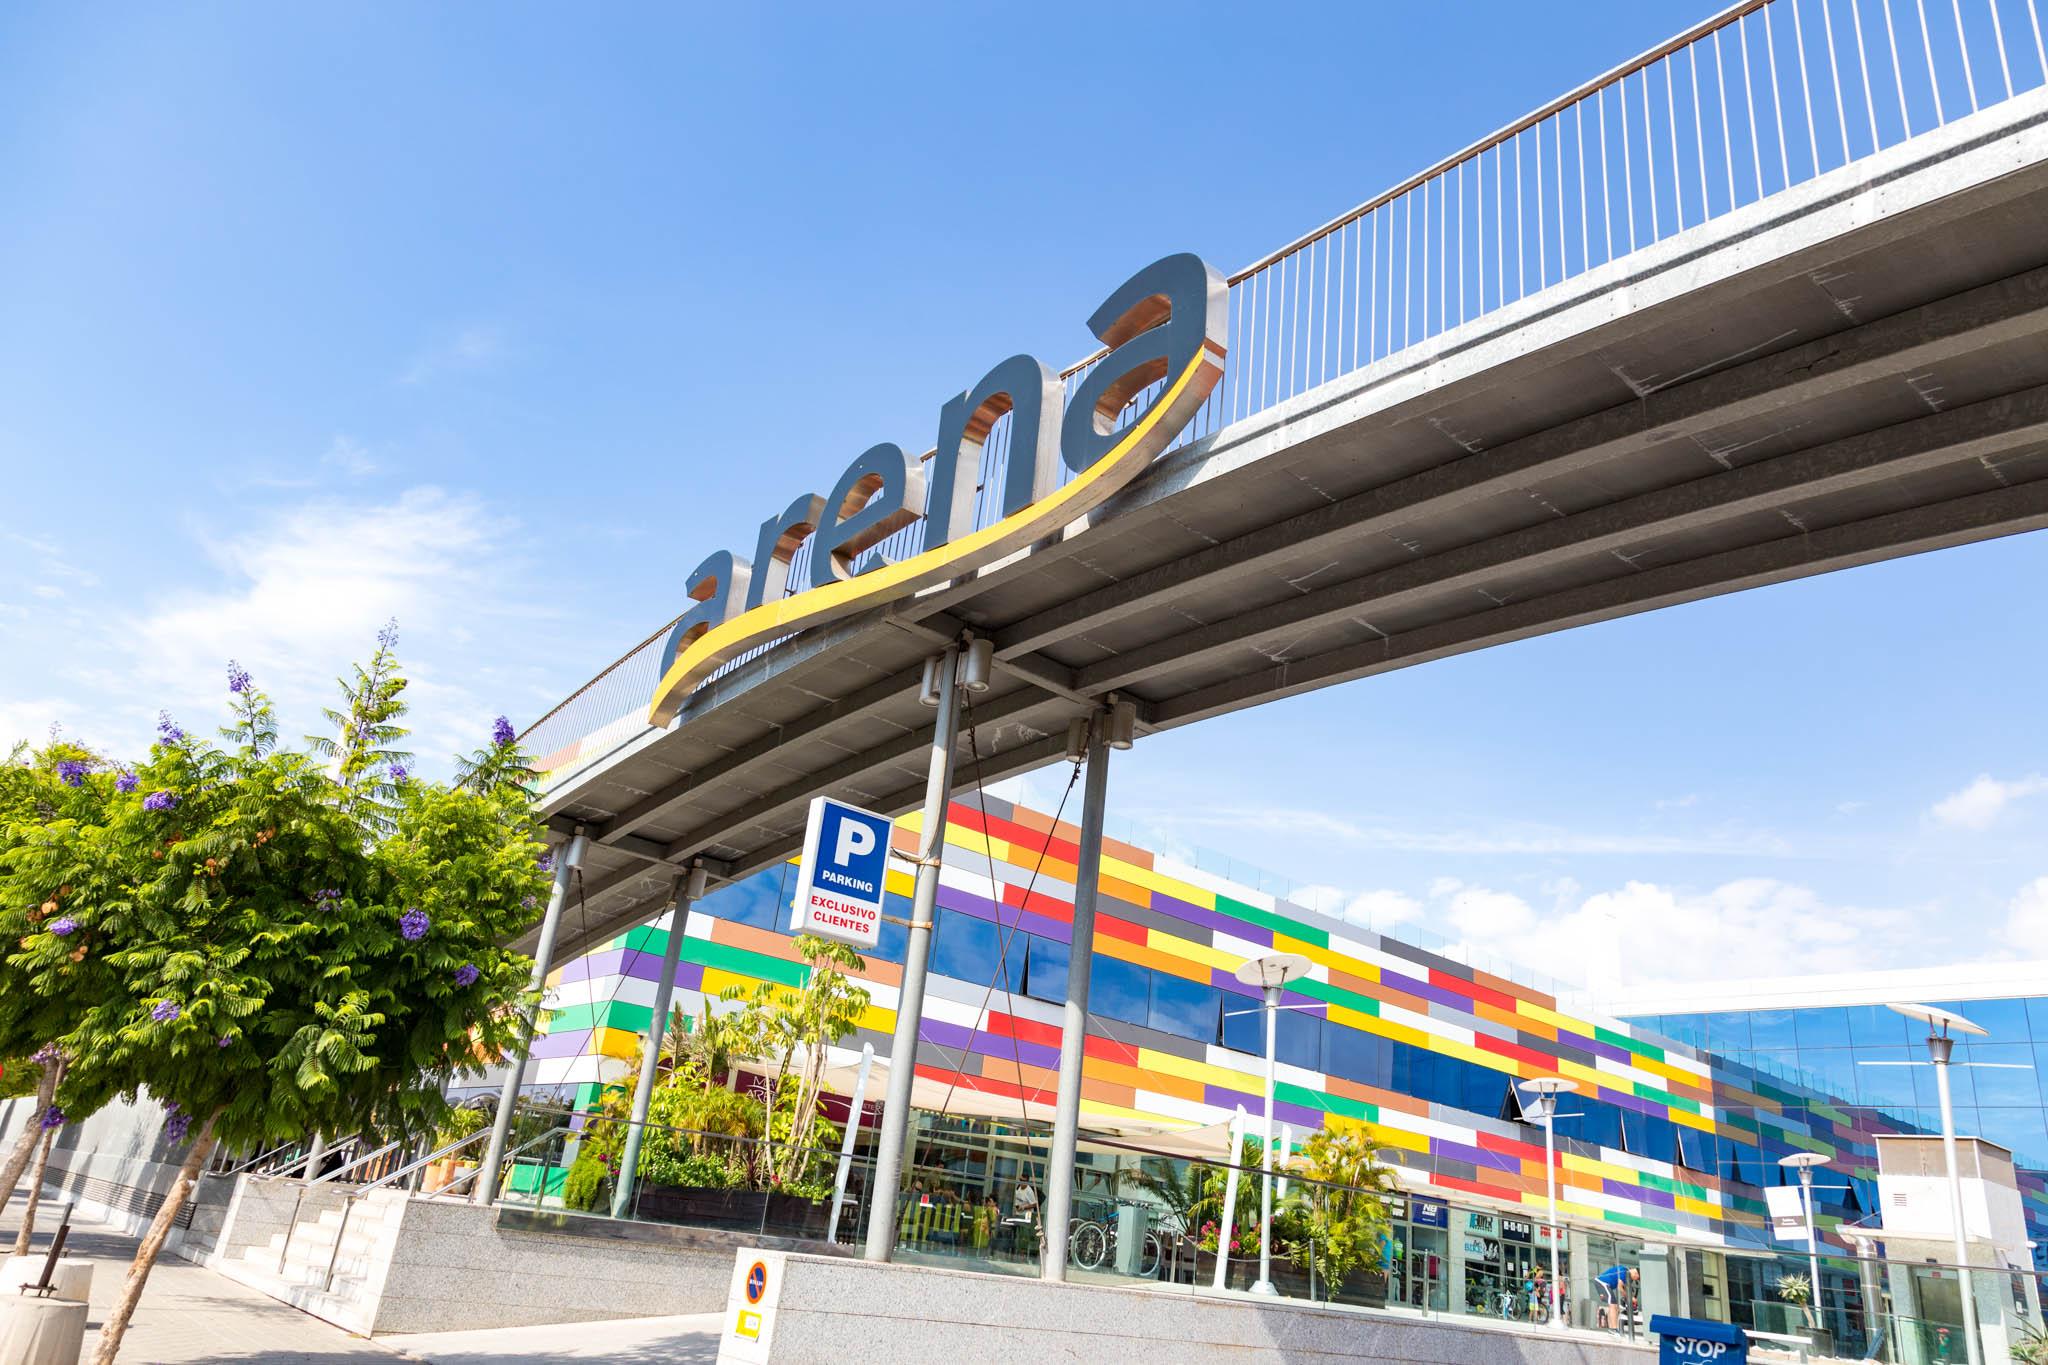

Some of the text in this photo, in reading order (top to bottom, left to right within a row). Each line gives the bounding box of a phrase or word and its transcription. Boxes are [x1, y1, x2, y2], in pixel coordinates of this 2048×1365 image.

[658, 252, 1224, 688] arena
[833, 816, 877, 868] P
[822, 869, 874, 893] PARKING
[810, 895, 877, 921] EXCLUSIVO
[813, 911, 870, 934] CLIENTES
[1673, 1336, 1727, 1359] STOP
